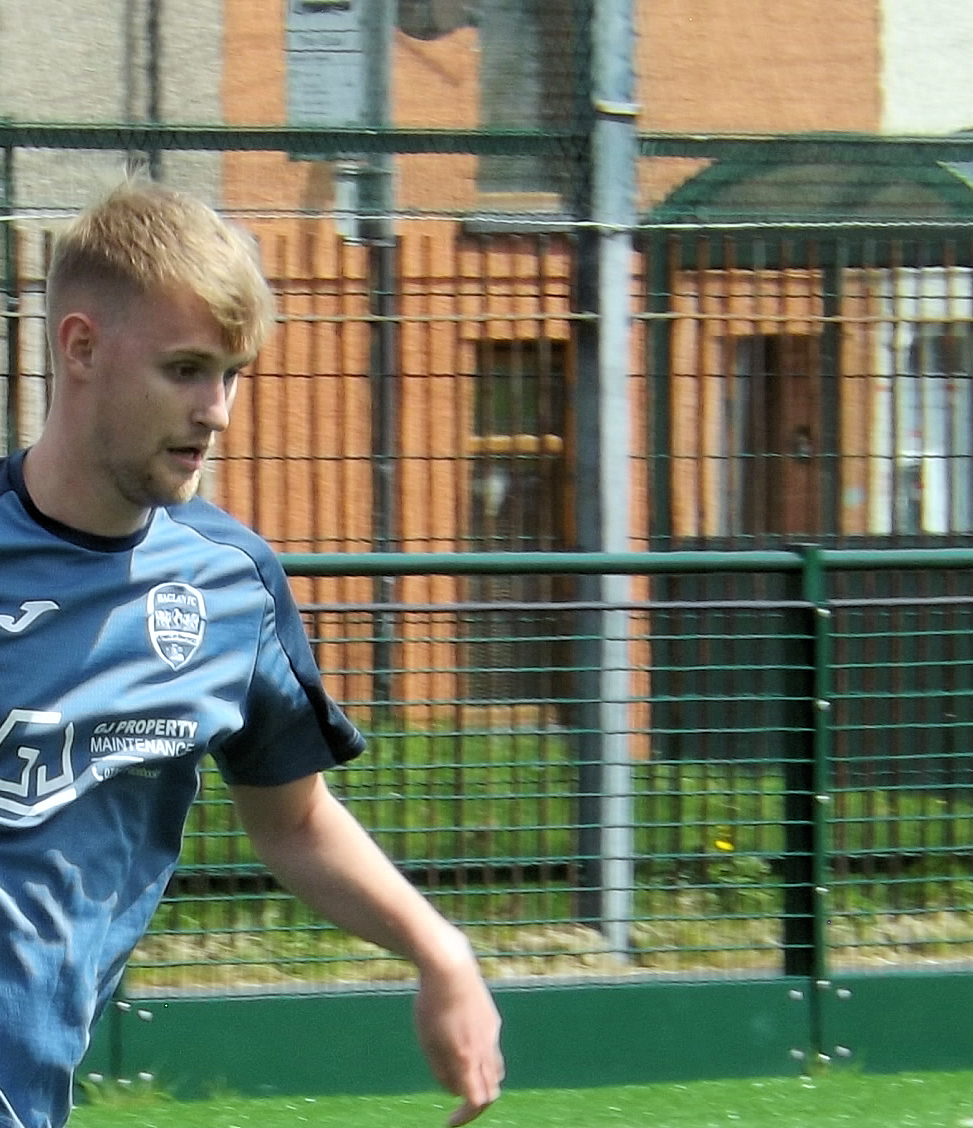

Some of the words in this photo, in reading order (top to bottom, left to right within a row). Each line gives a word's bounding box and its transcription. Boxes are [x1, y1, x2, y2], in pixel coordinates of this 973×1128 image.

[93, 722, 115, 734] GJ
[115, 719, 198, 739] PROPERTY
[90, 736, 195, 757] MAINTENANCE
